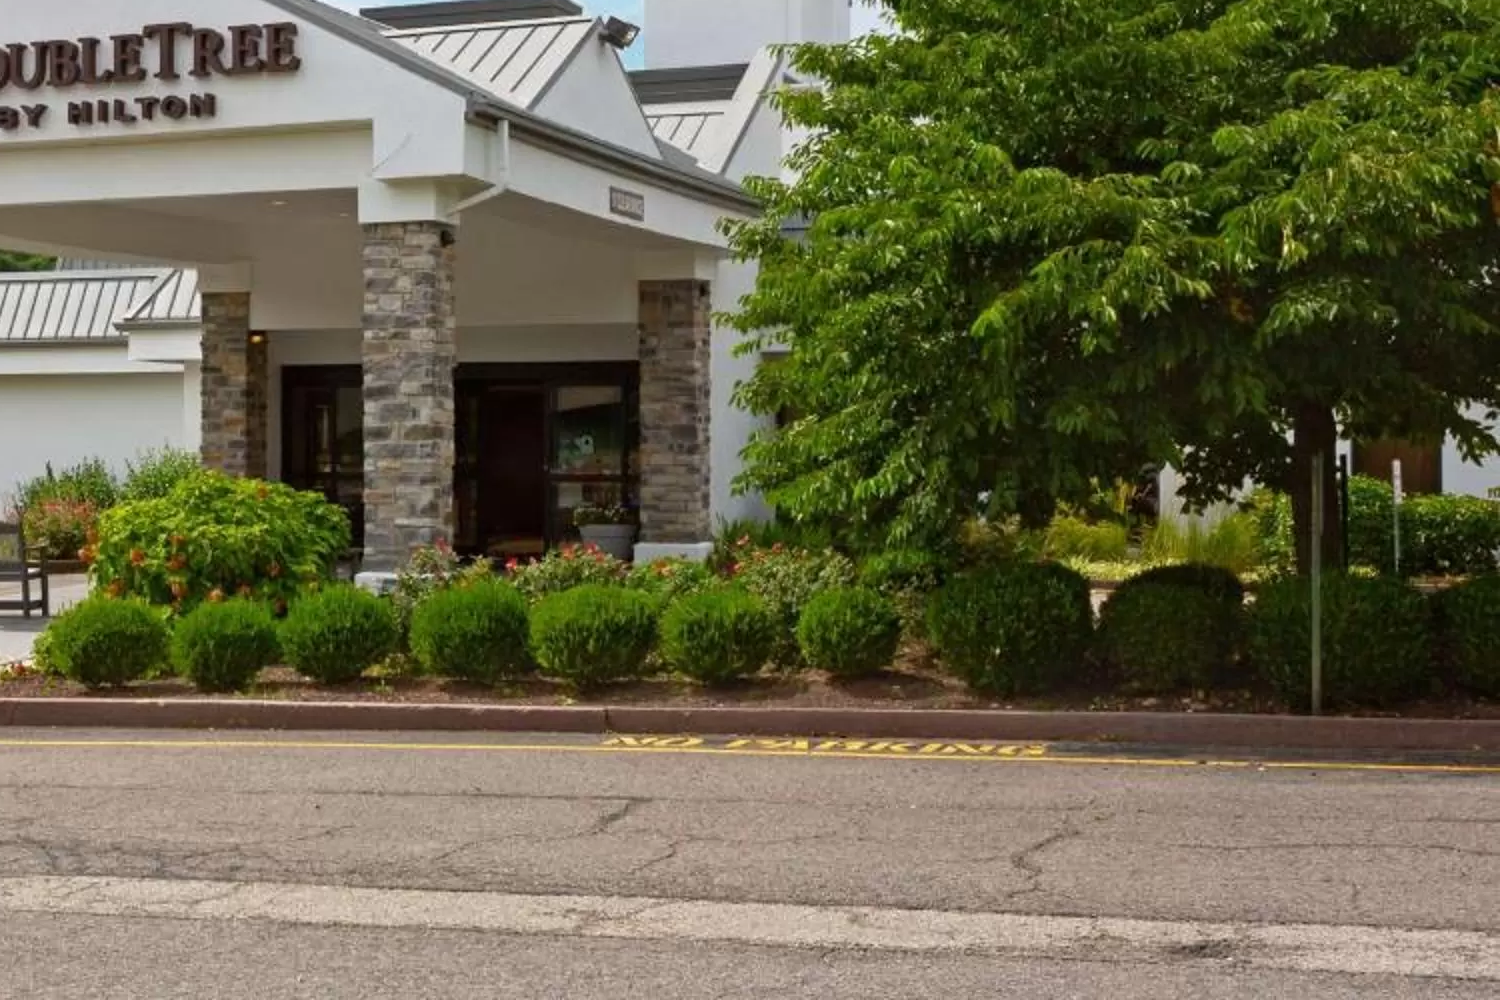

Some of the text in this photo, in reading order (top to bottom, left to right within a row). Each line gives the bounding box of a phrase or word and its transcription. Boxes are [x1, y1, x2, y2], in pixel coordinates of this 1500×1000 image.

[67, 93, 217, 126] HILTON
[603, 737, 1046, 756] NO PARKING
